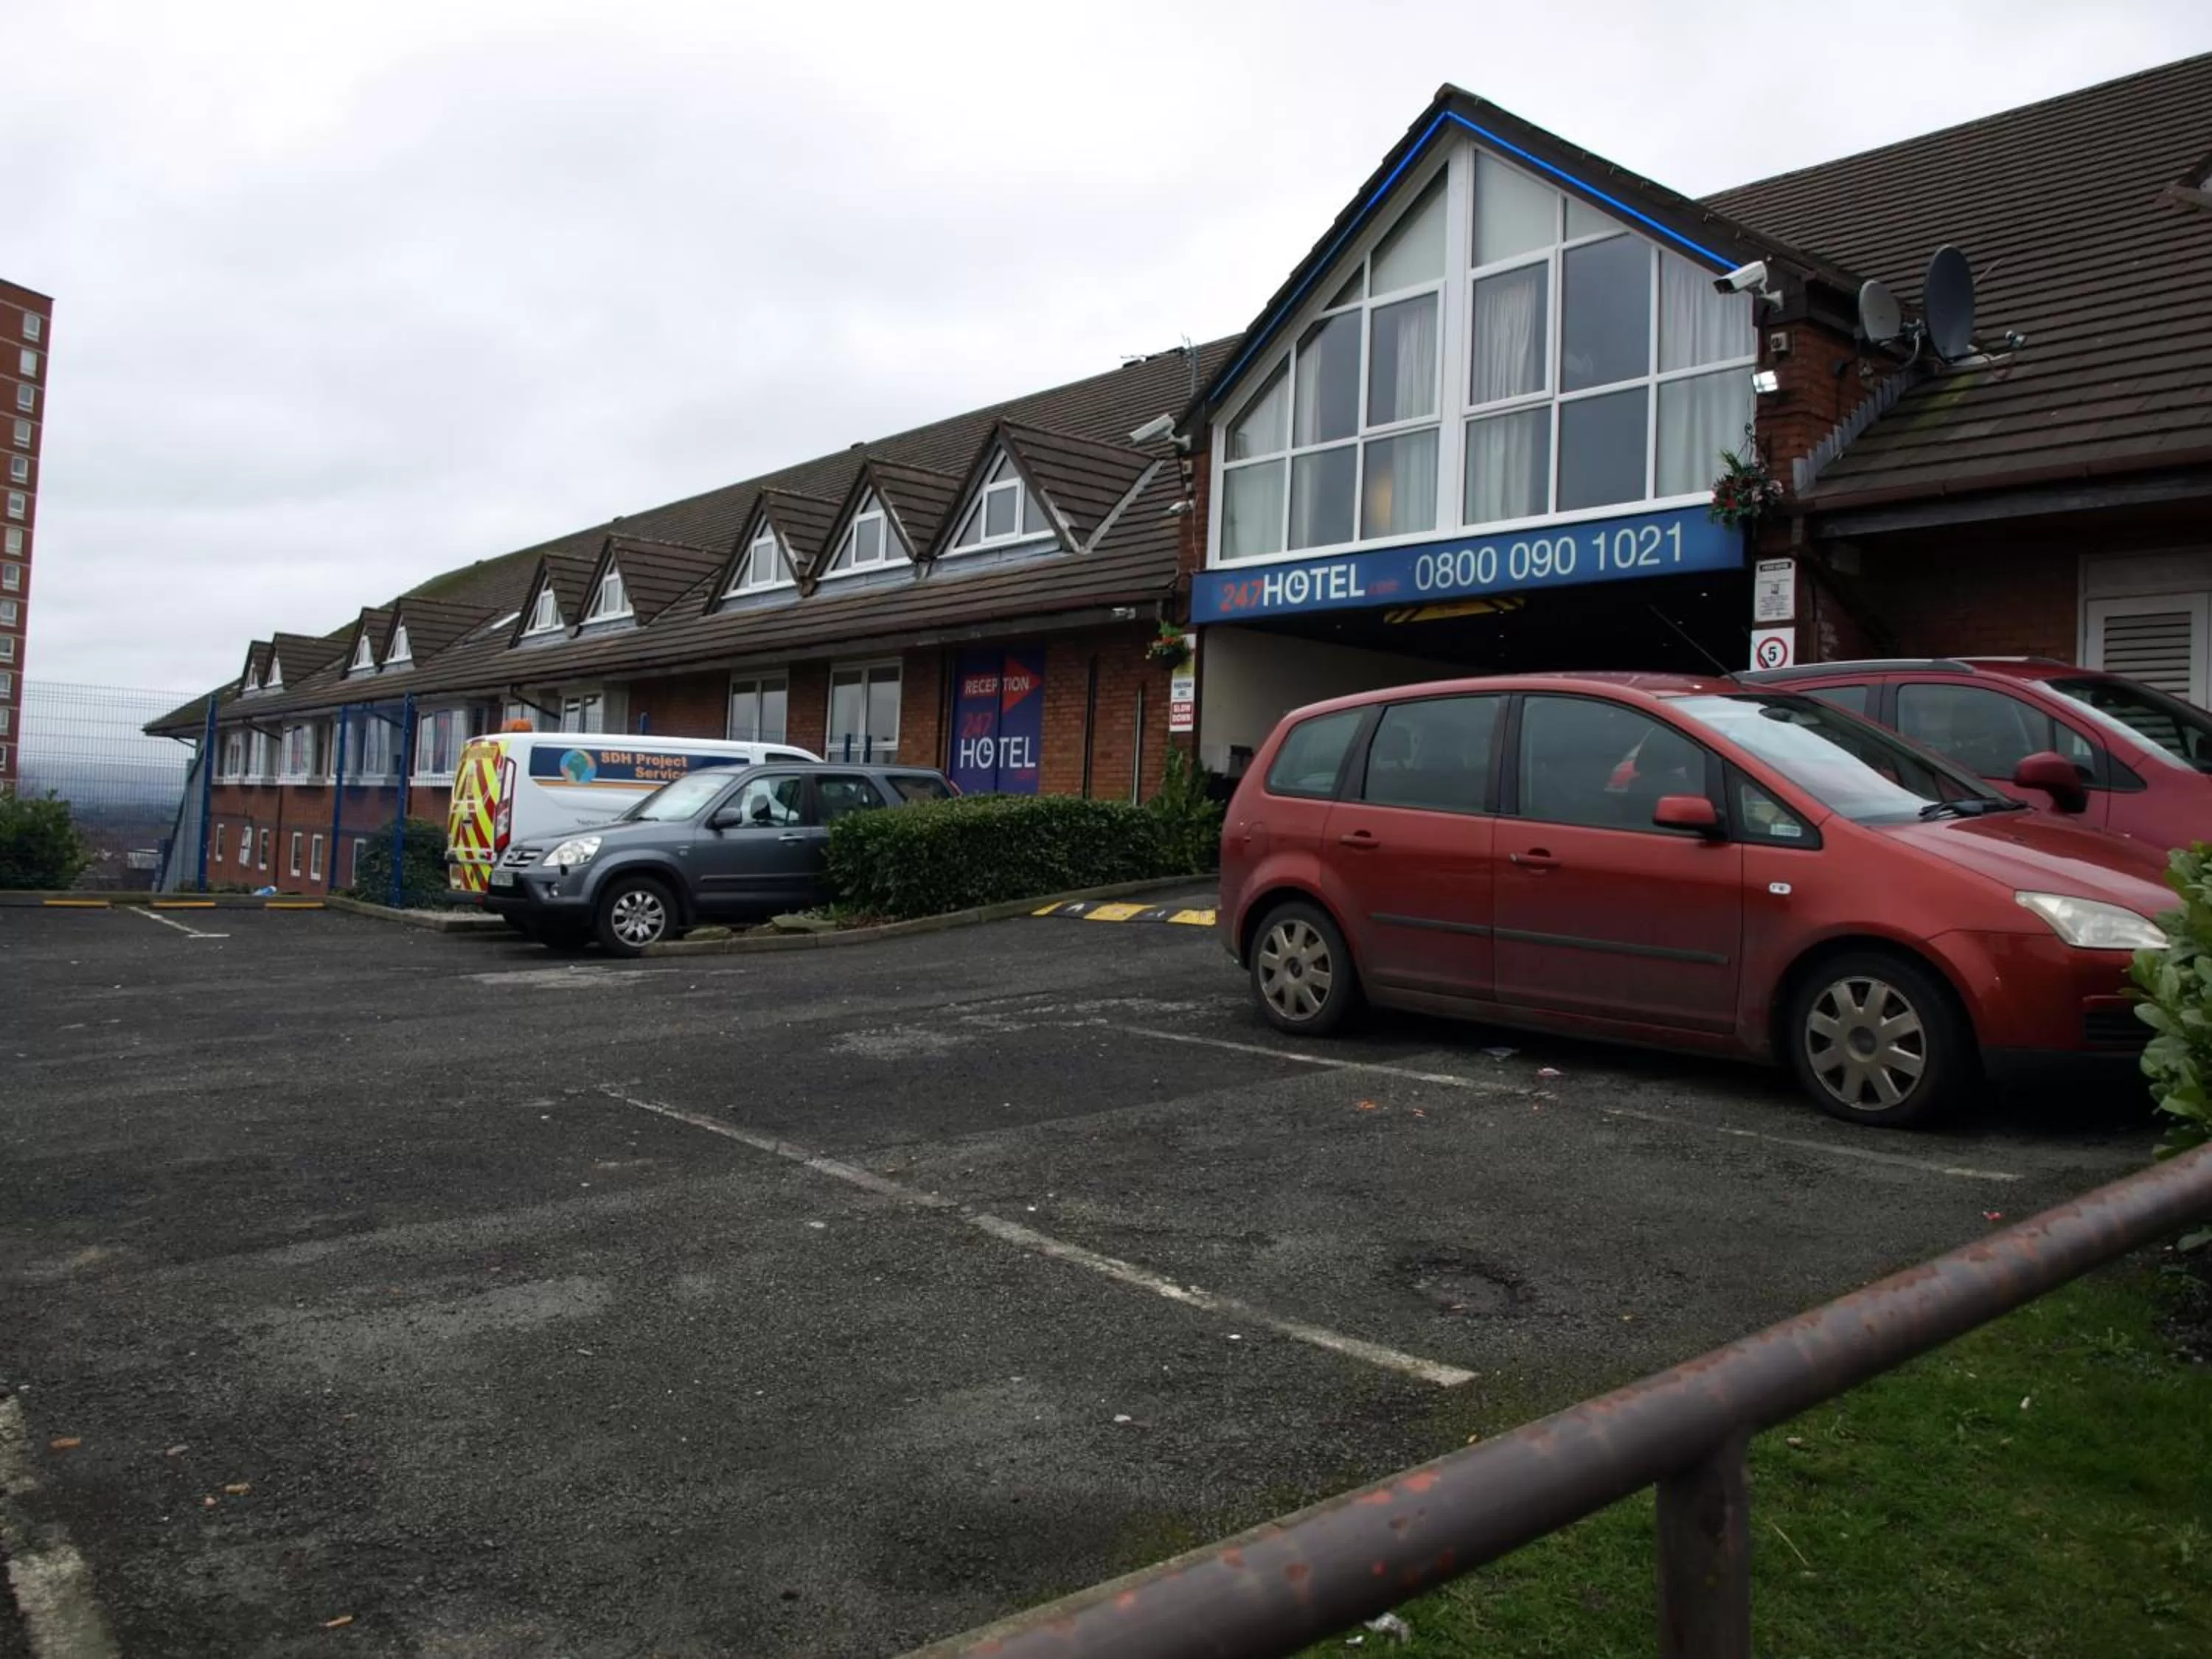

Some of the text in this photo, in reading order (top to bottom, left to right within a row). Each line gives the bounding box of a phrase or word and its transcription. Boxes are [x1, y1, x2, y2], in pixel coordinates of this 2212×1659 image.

[1415, 546, 1498, 590] 0800
[1509, 536, 1576, 580] 090
[1592, 521, 1681, 571] 1021
[1768, 646, 1776, 661] 5
[965, 676, 1030, 694] RECEPTION
[1173, 703, 1191, 713] SLOW
[1172, 714, 1191, 723] DOWN
[601, 752, 687, 768] SDH Project
[960, 737, 1036, 768] HOTEL
